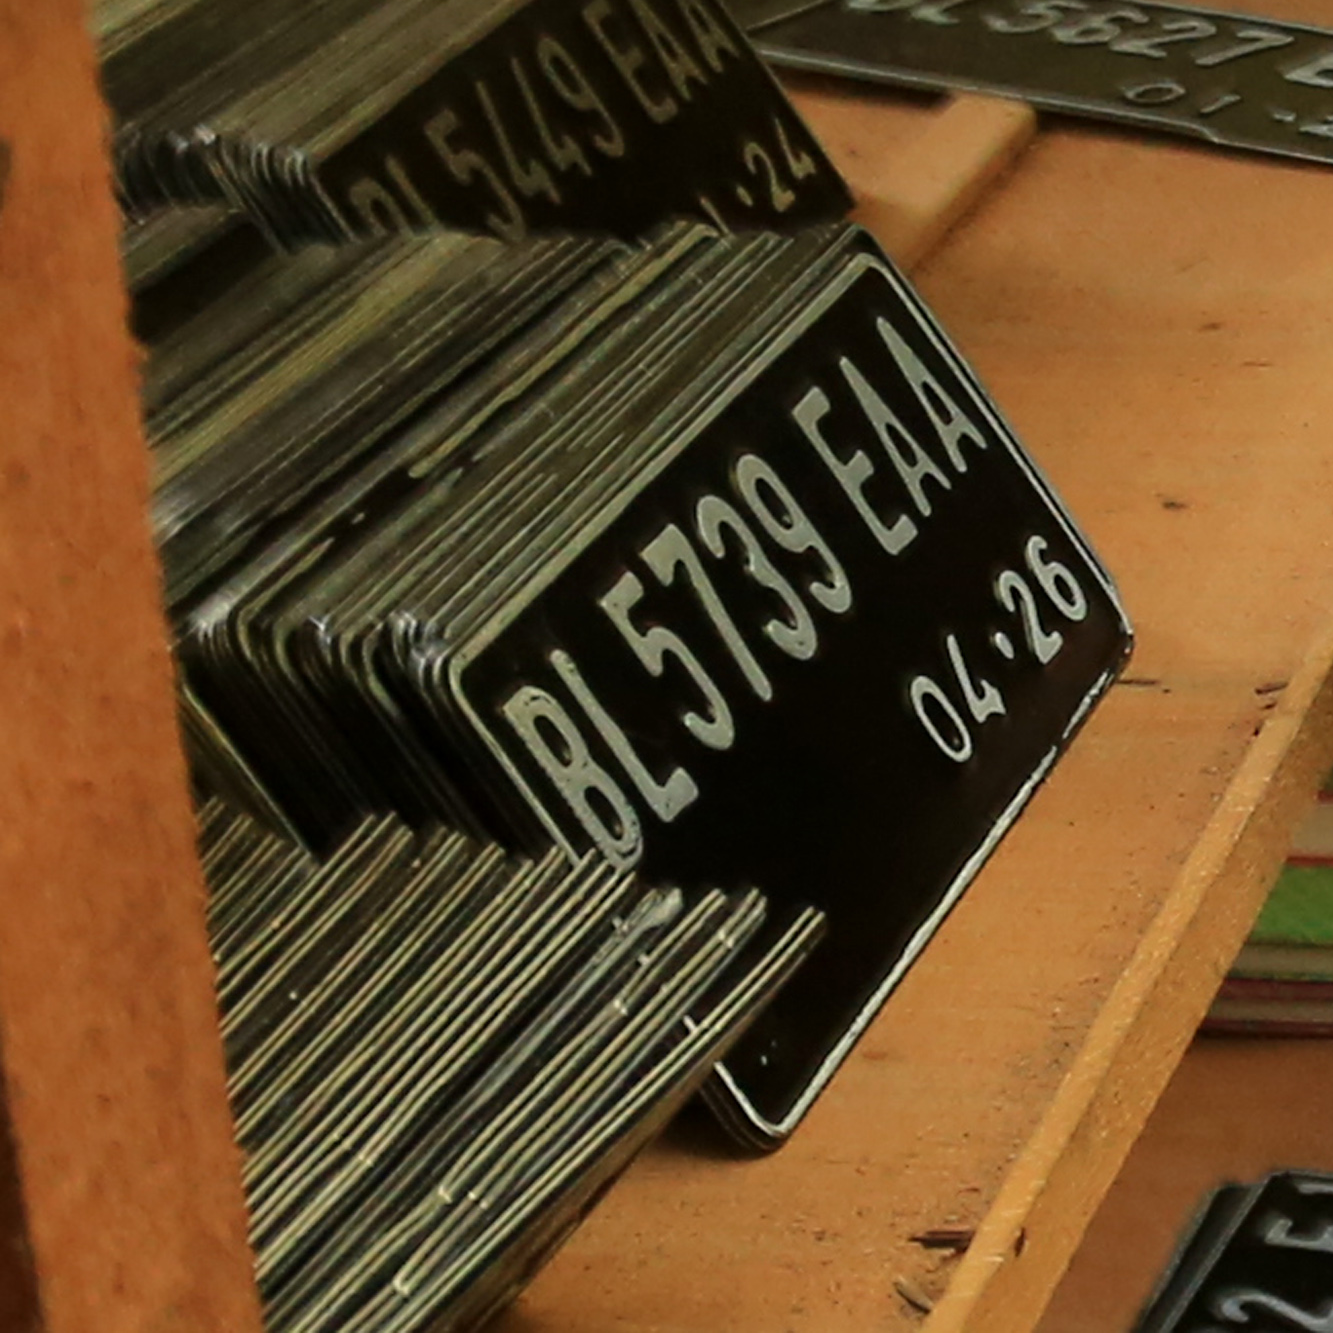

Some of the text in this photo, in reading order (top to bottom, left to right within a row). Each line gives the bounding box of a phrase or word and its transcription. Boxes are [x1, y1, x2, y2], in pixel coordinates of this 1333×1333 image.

[423, 35, 625, 243] 5449
[503, 317, 987, 869] BL 5739 EAA
